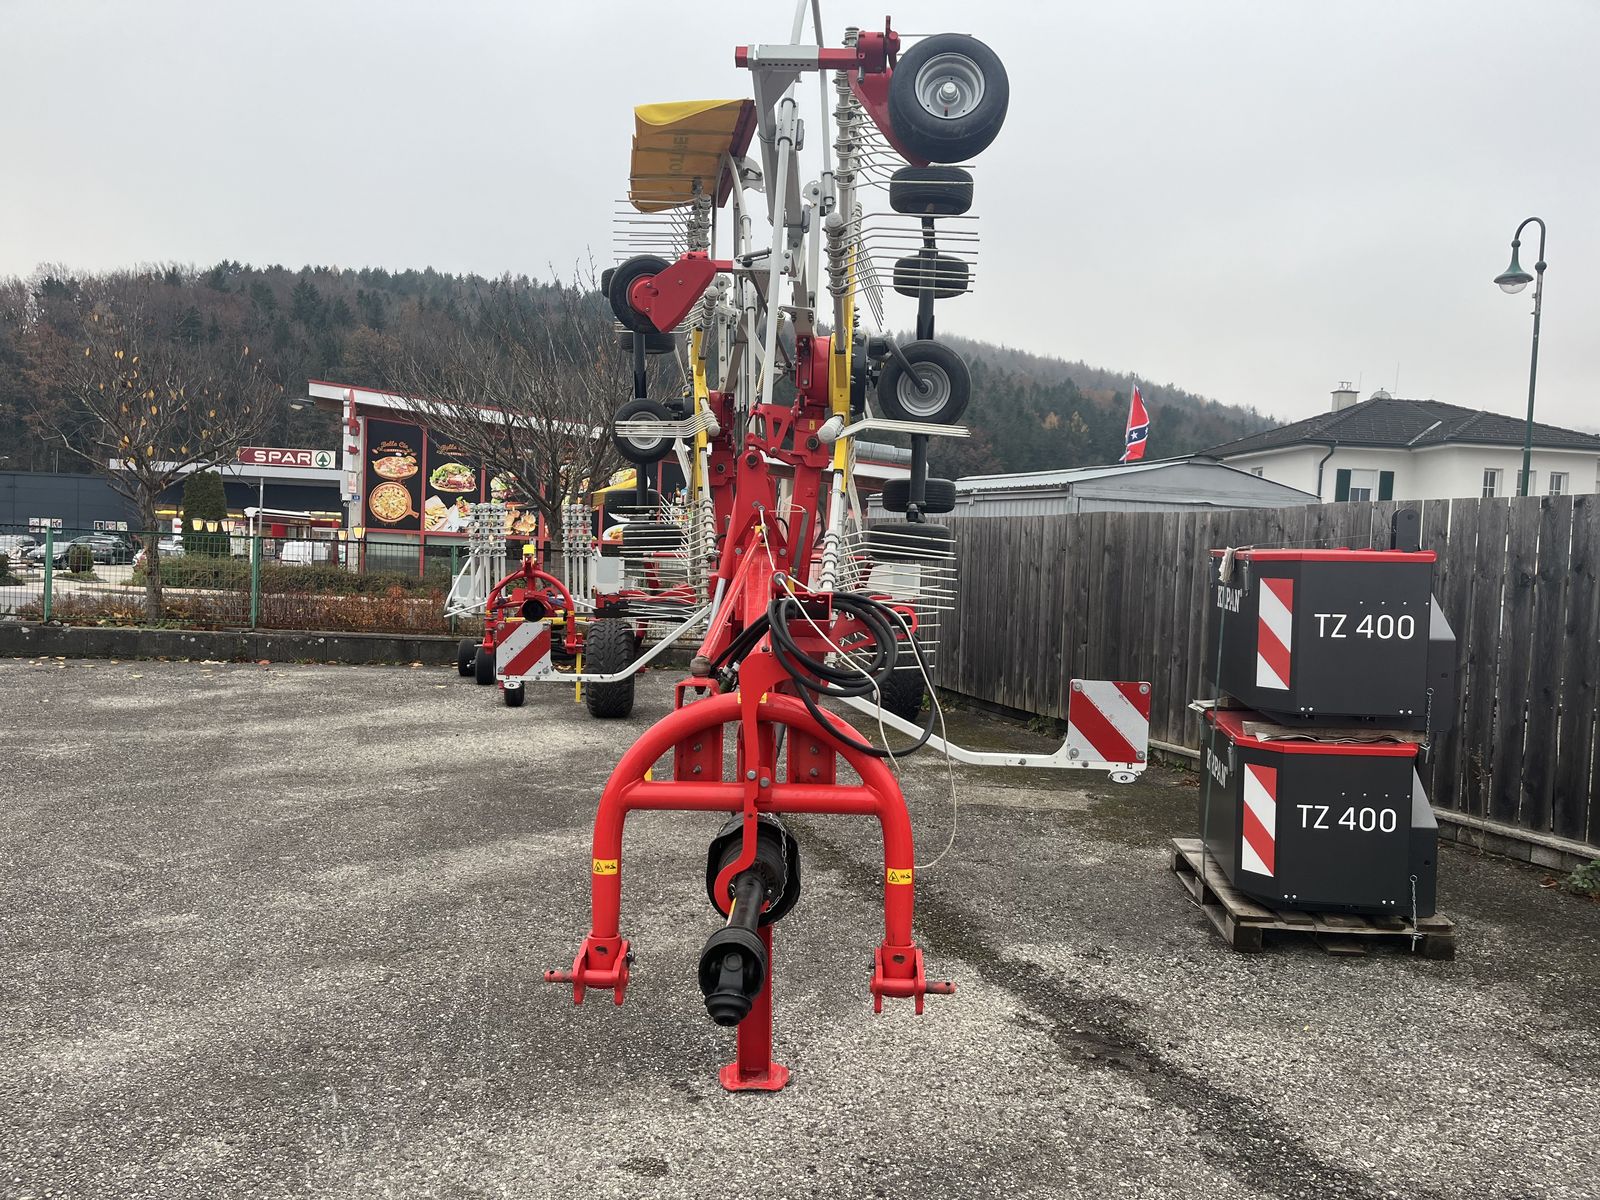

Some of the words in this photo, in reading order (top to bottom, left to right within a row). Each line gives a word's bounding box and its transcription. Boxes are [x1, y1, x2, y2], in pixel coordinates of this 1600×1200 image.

[254, 450, 311, 464] SPAR
[1314, 613, 1347, 638] TZ
[1356, 614, 1415, 640] 400
[1297, 804, 1330, 829] TZ
[1338, 807, 1397, 833] 400
